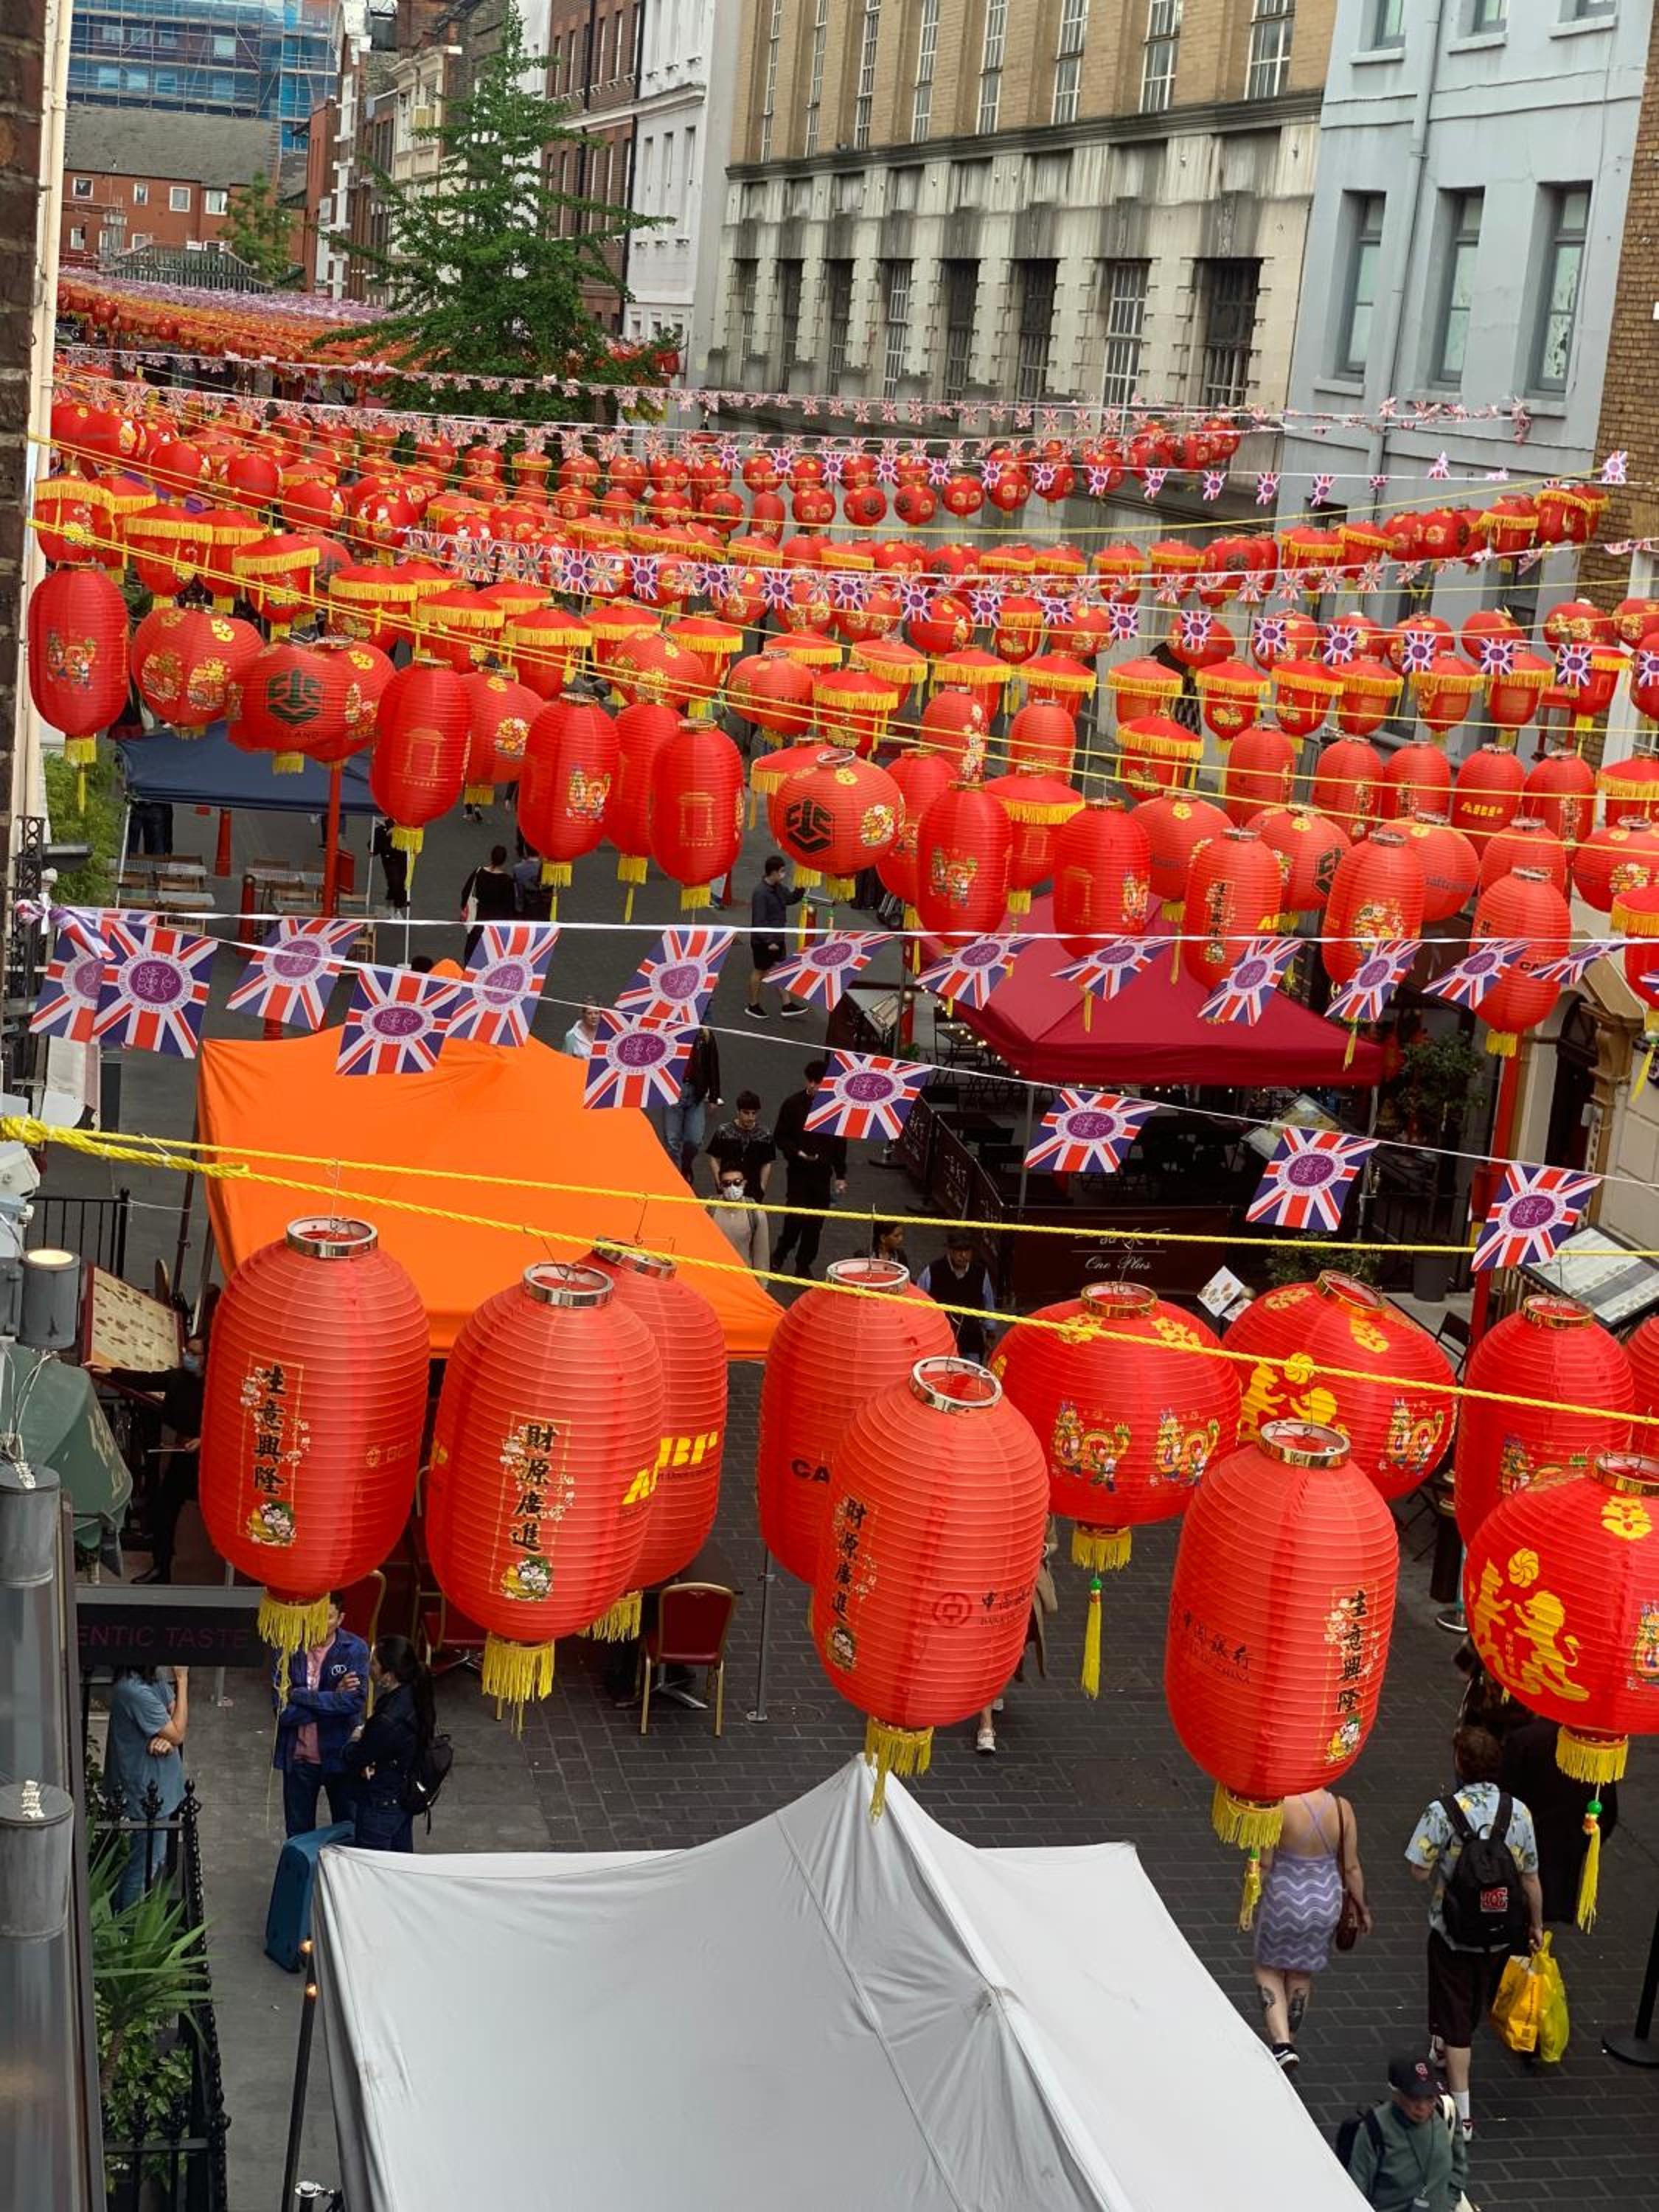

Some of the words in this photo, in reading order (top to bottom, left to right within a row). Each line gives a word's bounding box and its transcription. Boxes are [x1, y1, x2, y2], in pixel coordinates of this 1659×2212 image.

[1085, 1256, 1110, 1270] One
[1117, 1256, 1152, 1270] Plus
[254, 1365, 286, 1495] 生意興隆
[510, 1424, 558, 1552] 財源廣進
[832, 1496, 868, 1621] 財源廣進
[165, 1627, 249, 1649] TASTE
[1338, 1590, 1368, 1713] 生意興隆
